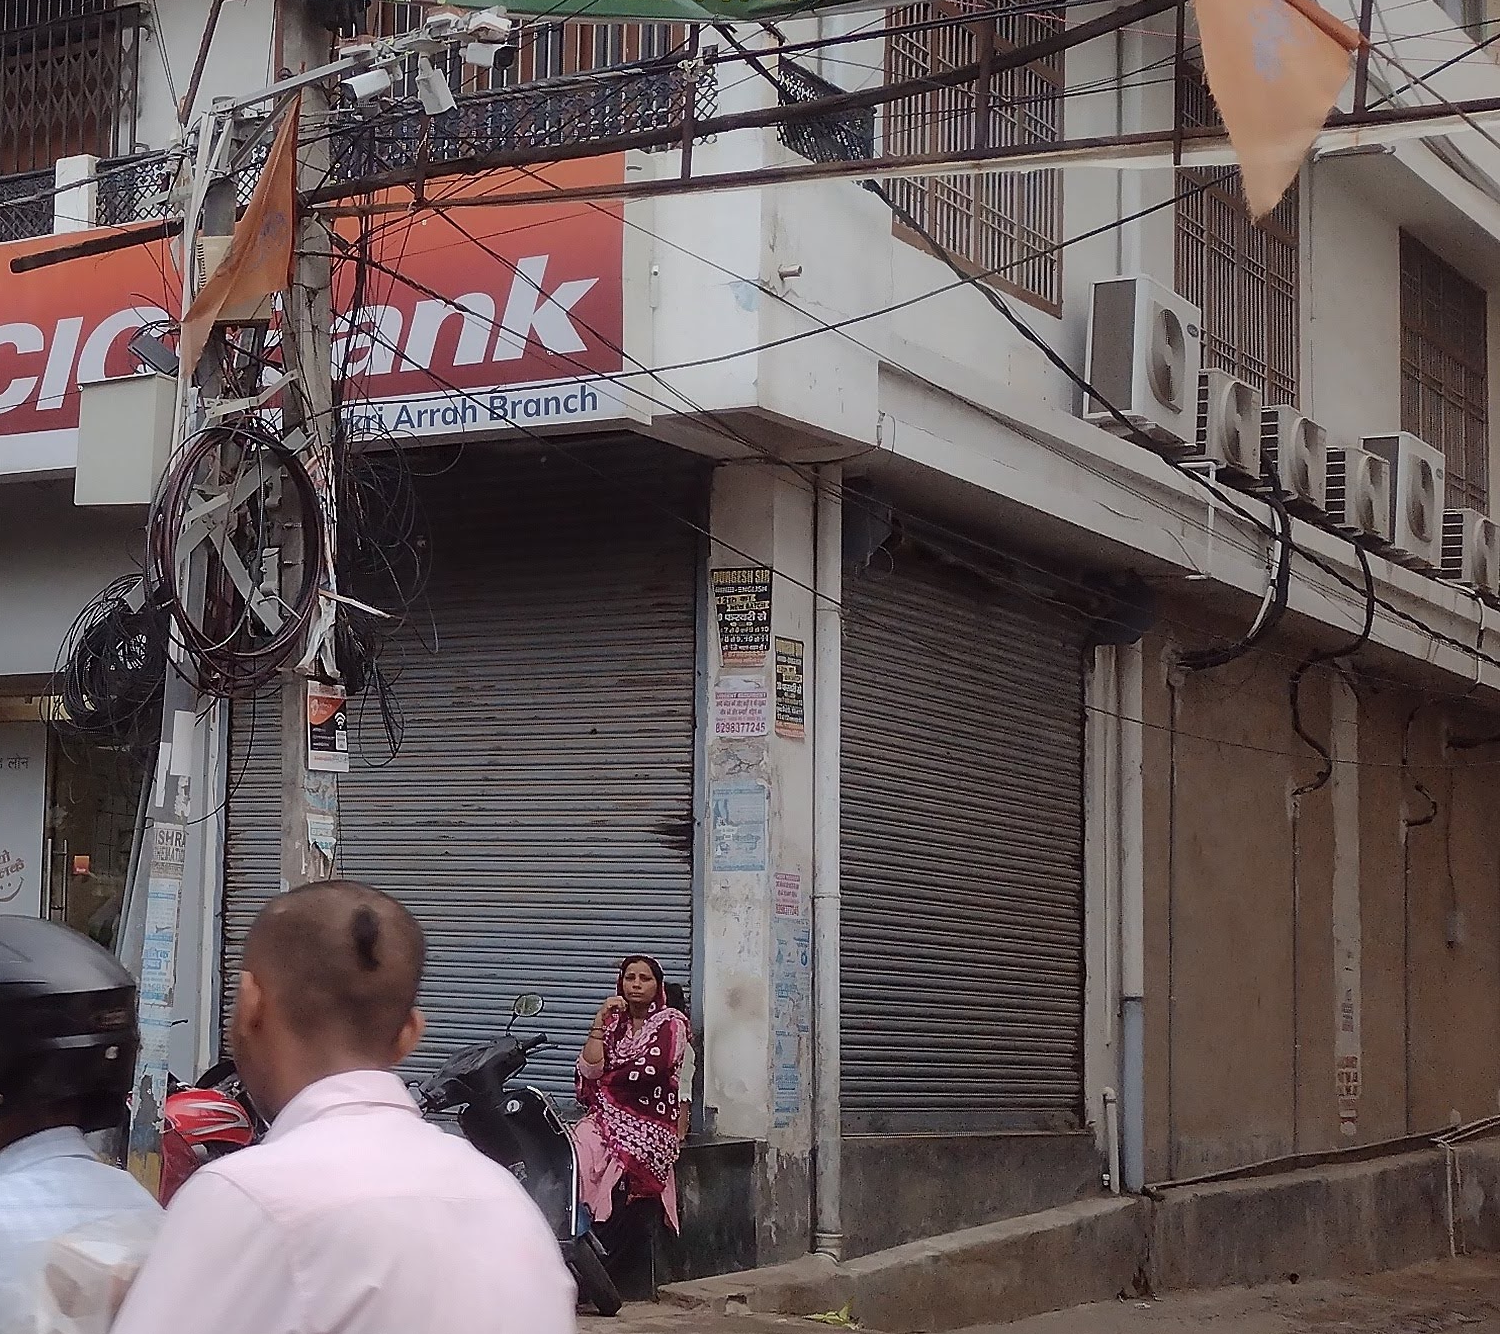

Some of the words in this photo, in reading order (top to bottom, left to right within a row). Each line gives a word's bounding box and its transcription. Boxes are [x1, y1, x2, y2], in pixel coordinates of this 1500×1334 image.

[328, 254, 600, 380] ank
[394, 398, 478, 430] Arrah
[489, 385, 598, 422] Branch
[6, 753, 30, 770] लोन
